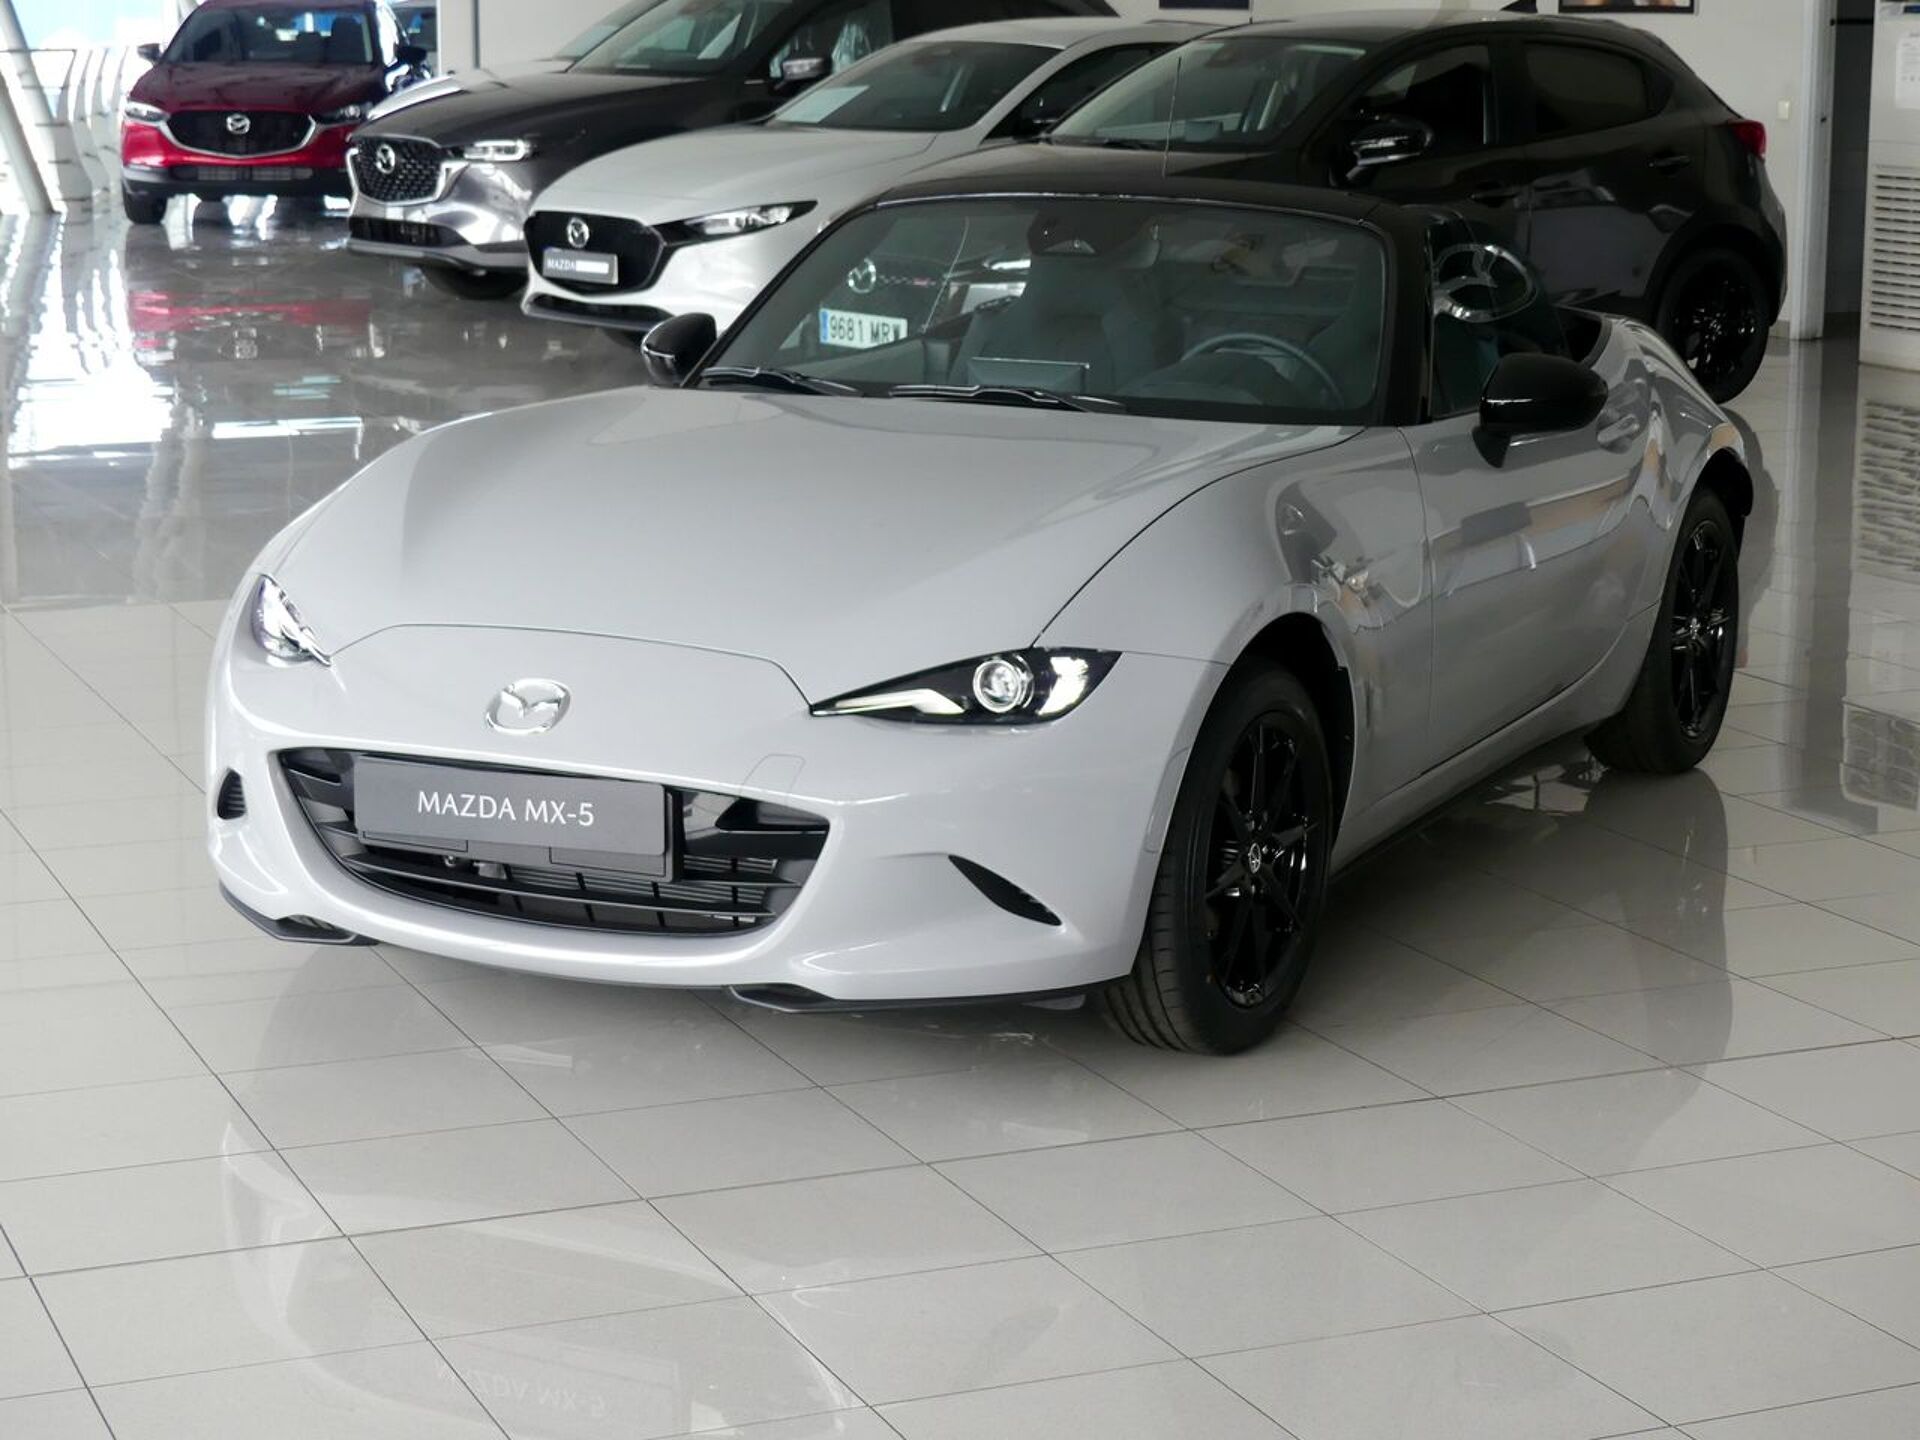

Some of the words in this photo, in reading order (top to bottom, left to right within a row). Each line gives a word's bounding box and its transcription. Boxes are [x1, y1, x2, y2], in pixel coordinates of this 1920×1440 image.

[830, 315, 863, 342] 9681
[417, 791, 517, 820] MAZDA
[524, 799, 595, 826] MX-5
